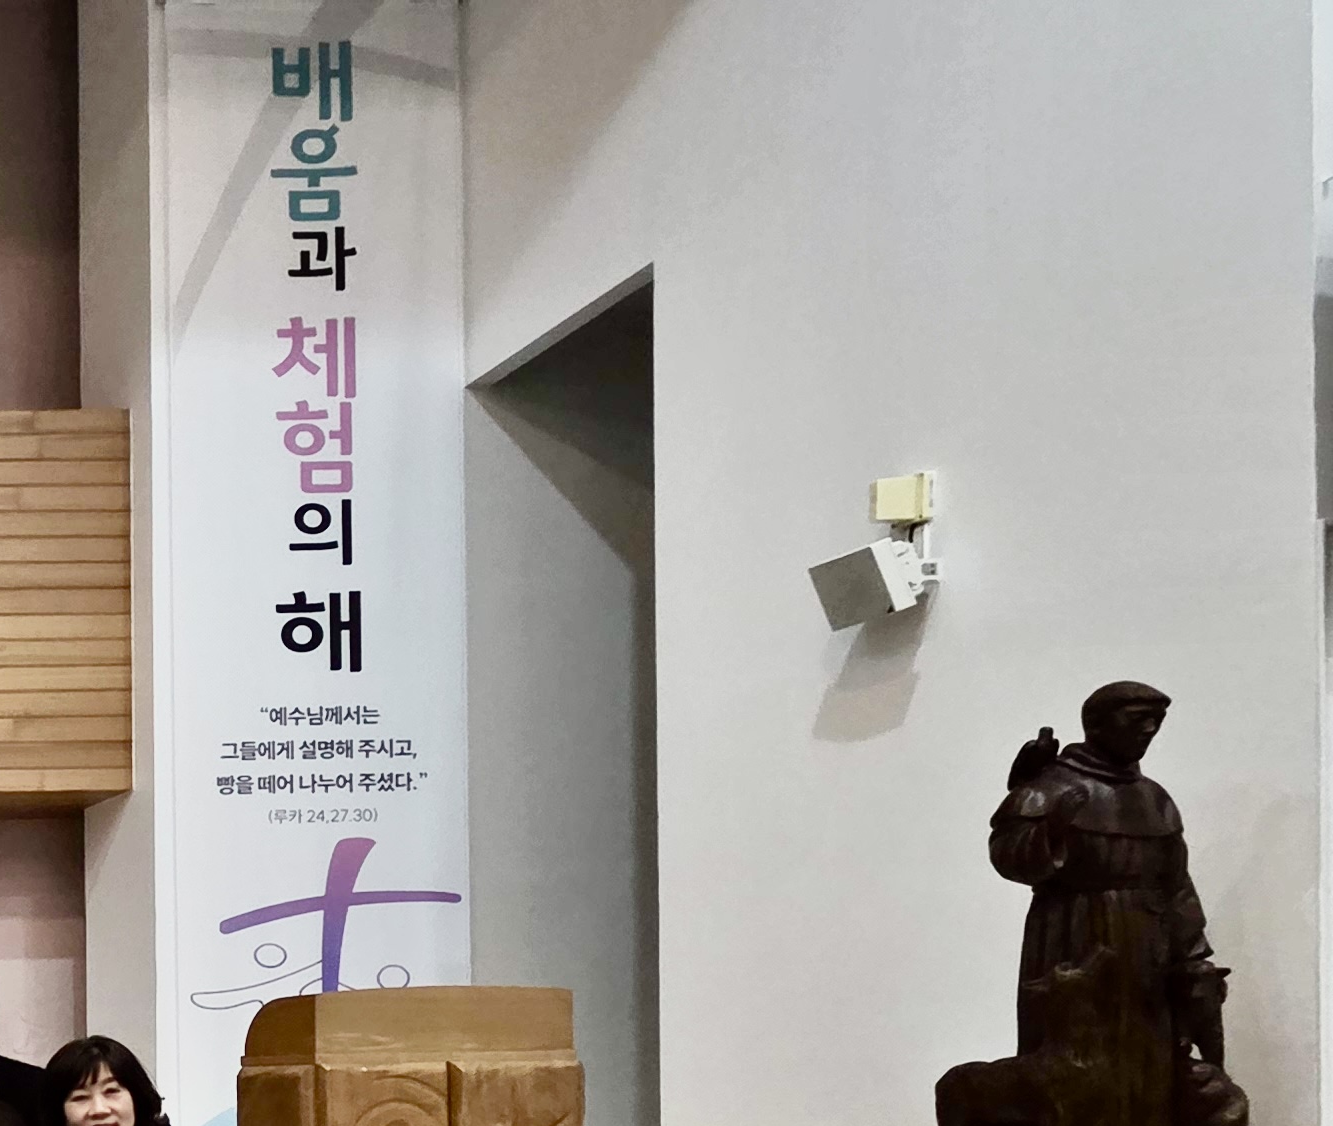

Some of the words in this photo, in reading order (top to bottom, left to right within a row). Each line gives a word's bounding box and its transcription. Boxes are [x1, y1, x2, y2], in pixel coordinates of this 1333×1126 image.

[270, 40, 358, 291] 배움과
[271, 316, 357, 566] 체험의
[274, 590, 362, 673] 해
[219, 740, 295, 761] 그들에게
[298, 739, 354, 760] 설명해
[357, 738, 418, 760] 주시고,
[216, 774, 255, 796] 빵을
[257, 773, 295, 795] 떼어
[298, 772, 354, 794] 나누어
[267, 808, 303, 825] (루카
[306, 807, 379, 824] 24,27.30)
